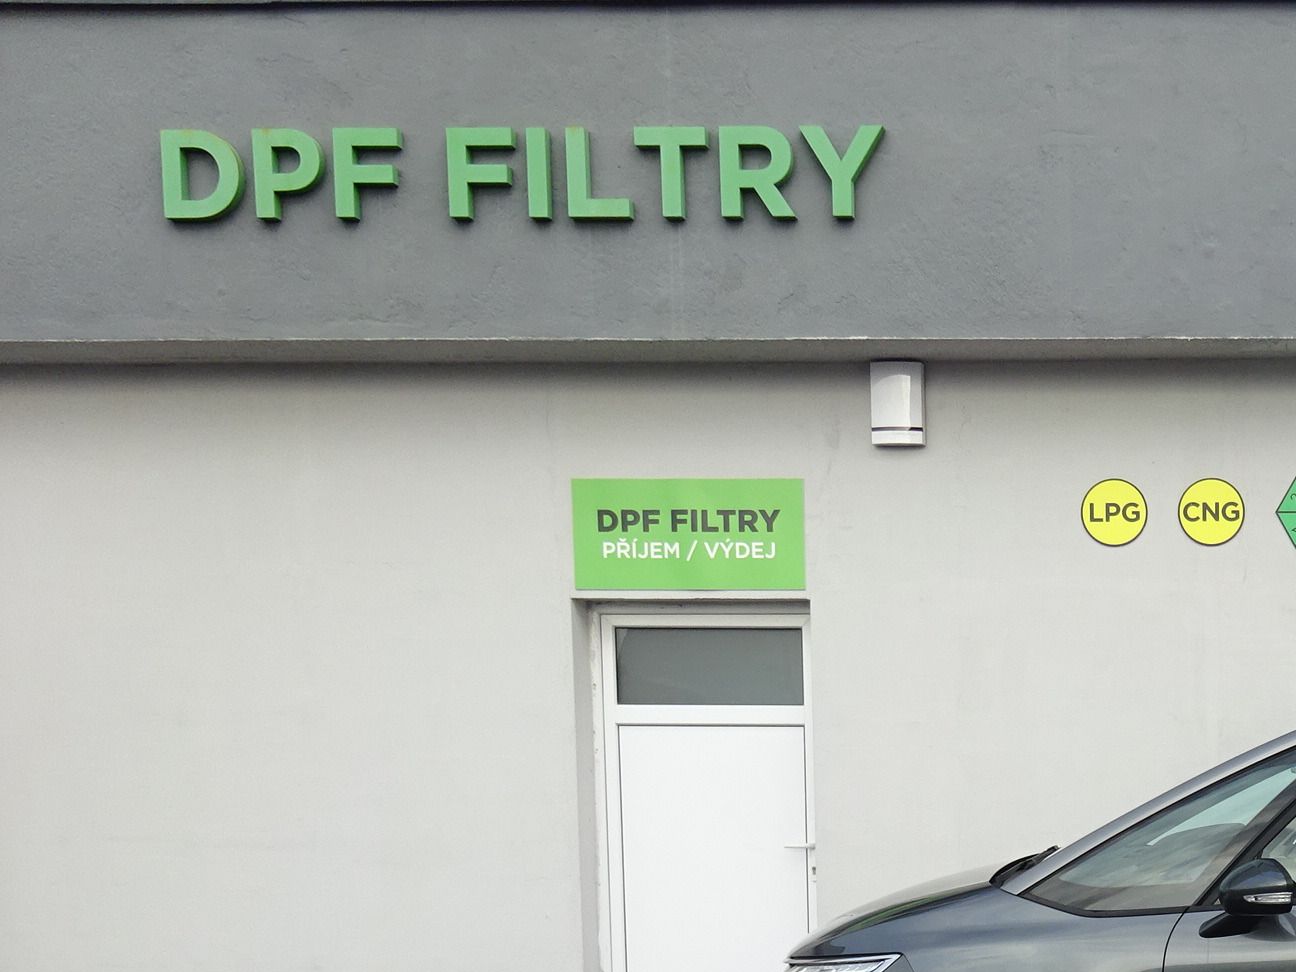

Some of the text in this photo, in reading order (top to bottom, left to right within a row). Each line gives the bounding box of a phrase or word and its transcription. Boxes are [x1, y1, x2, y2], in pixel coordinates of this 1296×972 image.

[160, 124, 886, 222] DPF FILTRY
[597, 509, 781, 533] DPF FILTRY
[1089, 502, 1141, 523] LPG
[1182, 501, 1240, 522] CNG
[602, 536, 776, 561] PŘÍJEM / VÝDEJ
